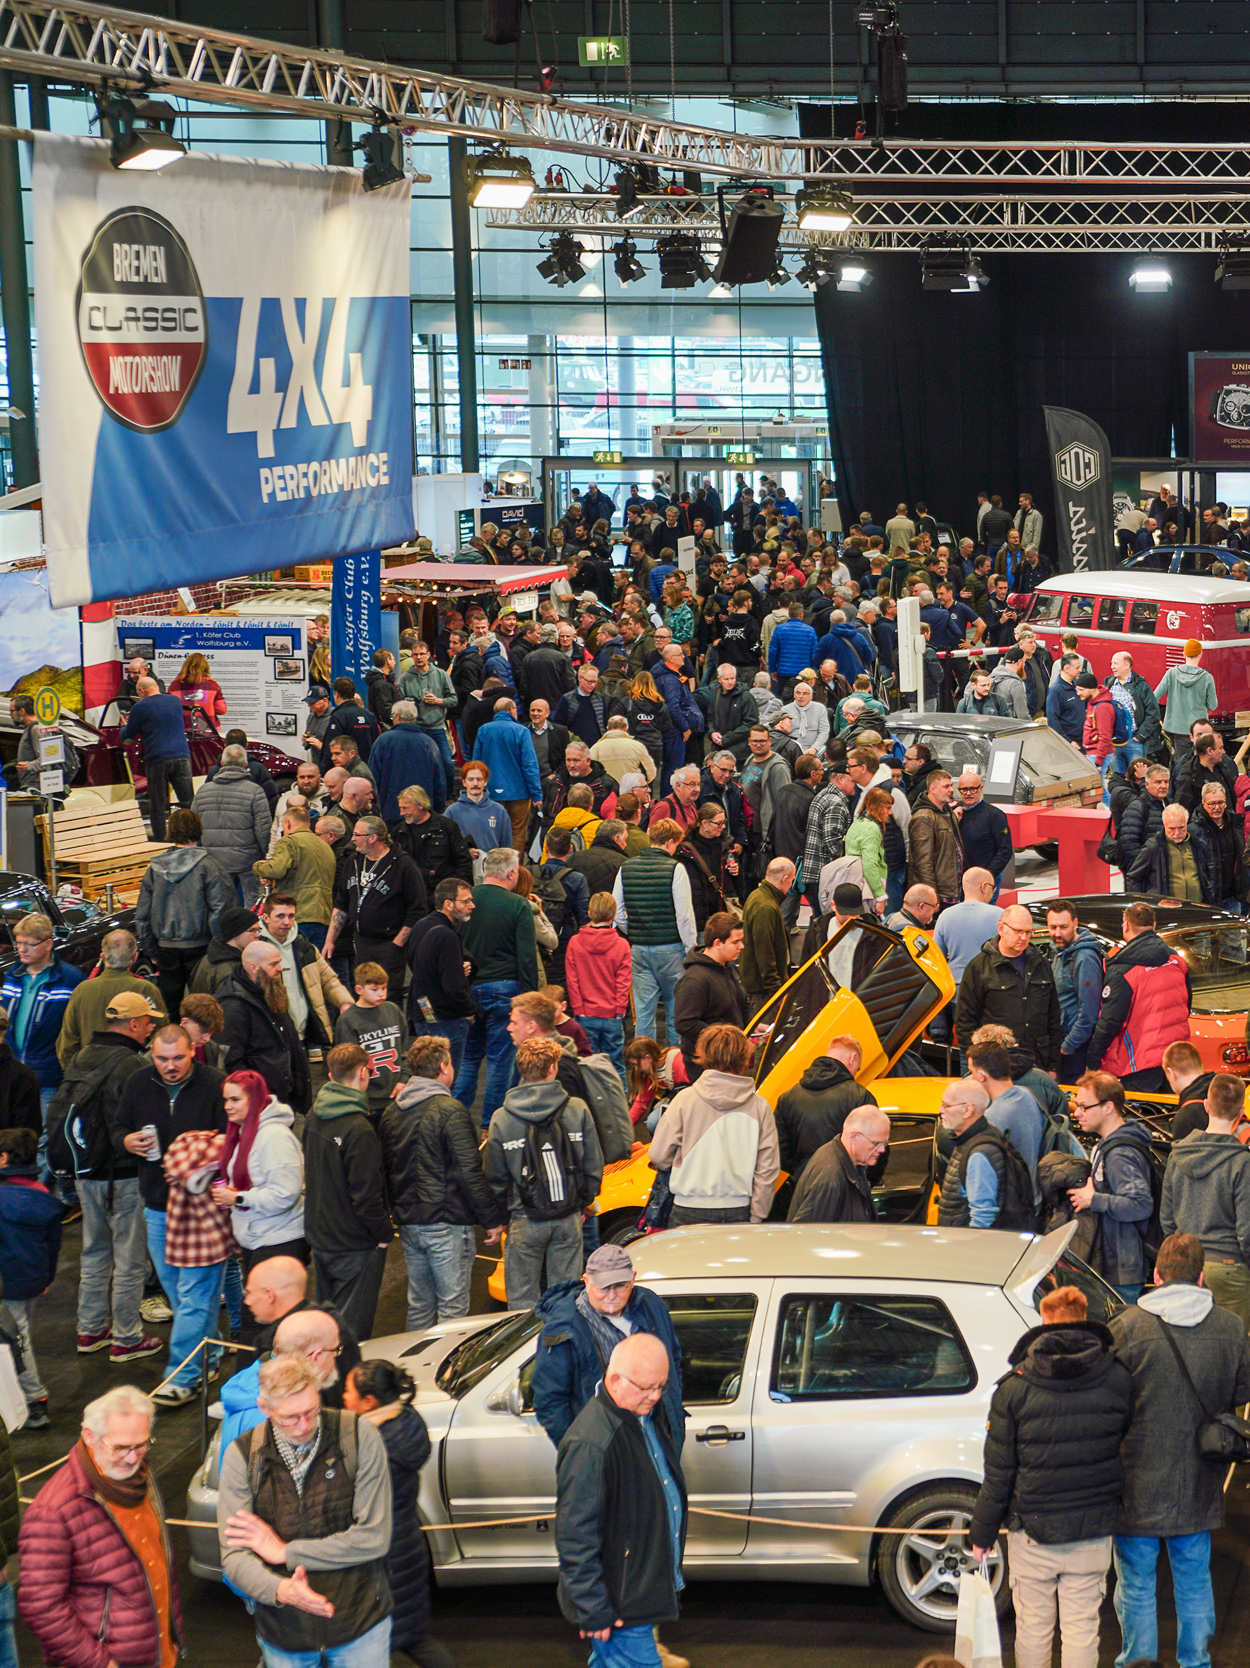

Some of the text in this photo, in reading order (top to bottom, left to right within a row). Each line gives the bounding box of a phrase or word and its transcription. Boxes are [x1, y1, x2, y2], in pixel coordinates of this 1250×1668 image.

[112, 242, 168, 284] BREMEN
[87, 305, 199, 333] CLASSIC
[108, 354, 182, 394] MOTORSHOW
[226, 296, 373, 459] 4X4
[258, 451, 390, 504] PERFORMANCE
[344, 558, 355, 599] Club
[175, 620, 204, 628] Norden
[345, 603, 357, 652] Käfer
[357, 555, 376, 680] Wolfsburg e.V.
[196, 640, 235, 648] Wolfsburg
[203, 631, 222, 639] Käfer
[223, 631, 241, 639] Club
[41, 695, 54, 718] H
[358, 1025, 400, 1043] SKYLINE
[504, 1522, 528, 1530] Classic
